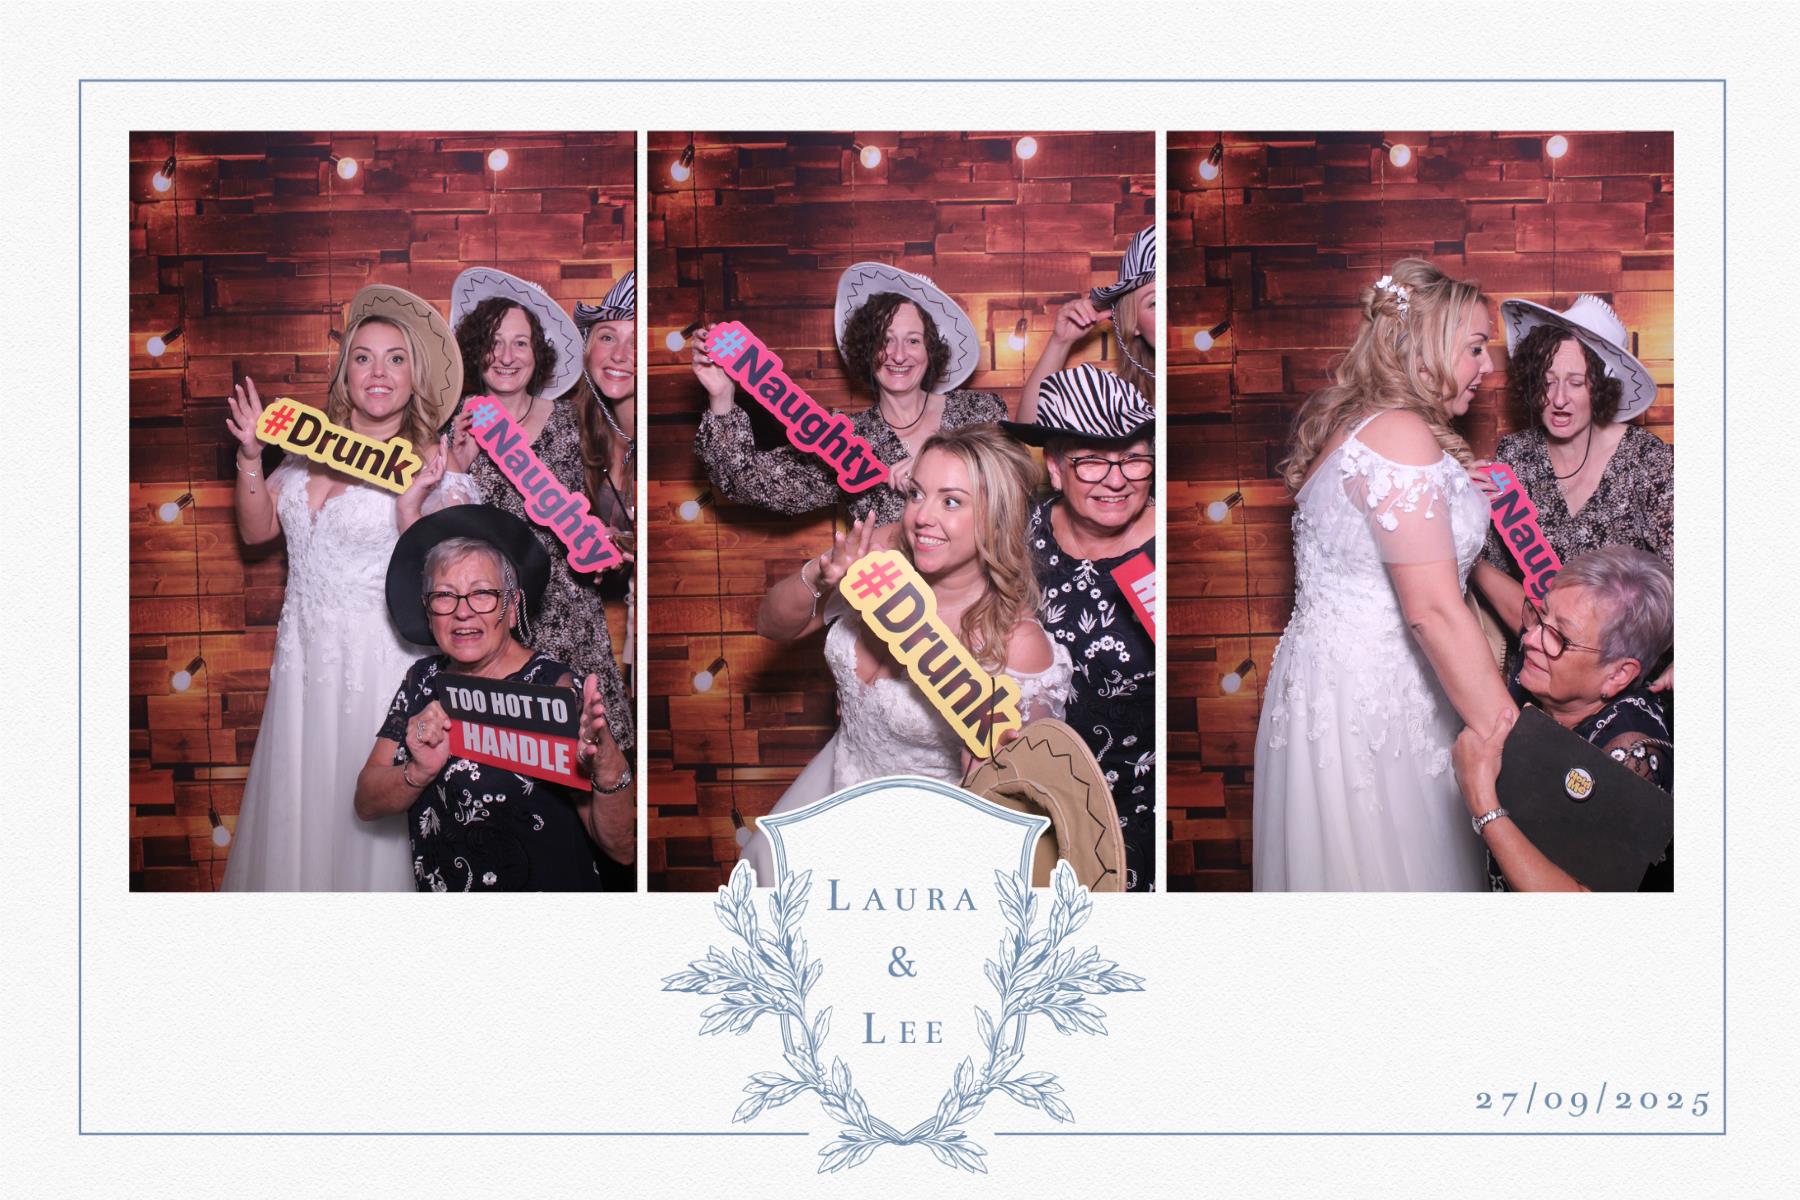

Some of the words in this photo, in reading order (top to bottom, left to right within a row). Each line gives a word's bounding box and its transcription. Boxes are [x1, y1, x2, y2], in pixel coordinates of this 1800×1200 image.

[265, 404, 415, 486] #Drunk
[710, 327, 881, 487] #Naughty
[471, 402, 614, 567] #Naughty
[446, 686, 487, 713] TOO
[490, 691, 533, 719] HOT
[537, 697, 568, 723] TO
[850, 560, 1011, 746] #Drunk
[462, 720, 571, 775] HANDLE
